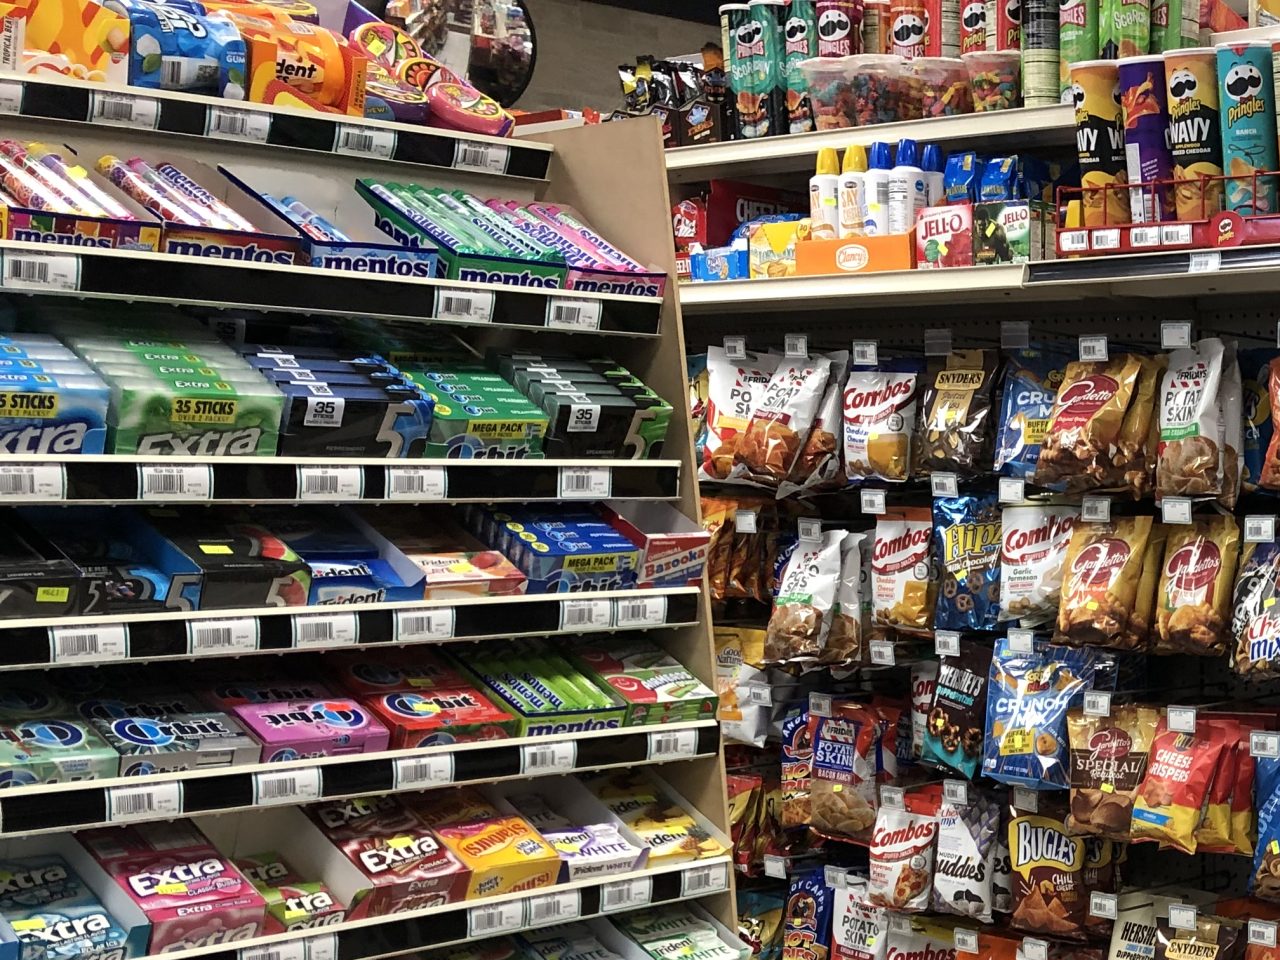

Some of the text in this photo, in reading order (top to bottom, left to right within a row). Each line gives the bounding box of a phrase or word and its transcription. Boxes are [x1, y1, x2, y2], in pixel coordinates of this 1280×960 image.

[227, 55, 246, 63] GUM
[1171, 98, 1200, 121] Pringles
[1228, 96, 1265, 122] Pringles
[1169, 118, 1211, 144] WAVY
[167, 239, 295, 266] mentos
[323, 256, 430, 278] mentos
[459, 267, 559, 289] mentos
[573, 276, 659, 298] mentos
[144, 352, 179, 362] Extra
[159, 366, 194, 374] Extra
[938, 371, 982, 384] SNYDER'S
[174, 380, 210, 389] Extra
[844, 377, 912, 410] Combos
[10, 395, 55, 410] STICKS
[175, 401, 234, 416] 35 STICKS
[313, 402, 335, 414] 35
[575, 408, 592, 420] 35
[472, 422, 524, 432] MEGA PACK
[845, 426, 869, 435] Cheddar
[138, 427, 261, 457] Extra
[847, 434, 866, 442] Cheese
[873, 527, 931, 562] Combos
[419, 557, 460, 567] Trident
[567, 556, 616, 568] MEGA PACK
[644, 550, 706, 577] Bazooka
[1008, 573, 1038, 581] Parmesan
[1012, 568, 1031, 577] Garlic
[876, 577, 896, 585] Cheddar
[877, 583, 895, 593] Cheese
[724, 648, 741, 658] Good
[939, 665, 985, 694] HERSHEY'S
[112, 717, 231, 746] Orbit
[528, 718, 619, 737] mentos
[815, 751, 853, 767] SKINS
[1077, 759, 1142, 773] SPECIAL
[1155, 750, 1193, 769] CHEESE
[818, 769, 836, 779] BACON
[1090, 769, 1125, 781] Request
[871, 822, 938, 848] Combos
[578, 841, 628, 857] WHITE
[1018, 821, 1078, 866] BUGLES
[606, 860, 632, 869] WHITE
[128, 857, 226, 898] Extra
[1052, 872, 1073, 885] CHILI
[187, 878, 241, 896] CLASSIC BUBBLE
[177, 903, 212, 916] Extra
[841, 916, 879, 936] POTATO
[654, 938, 693, 957] Trident
[1169, 941, 1216, 959] SNYDER'S
